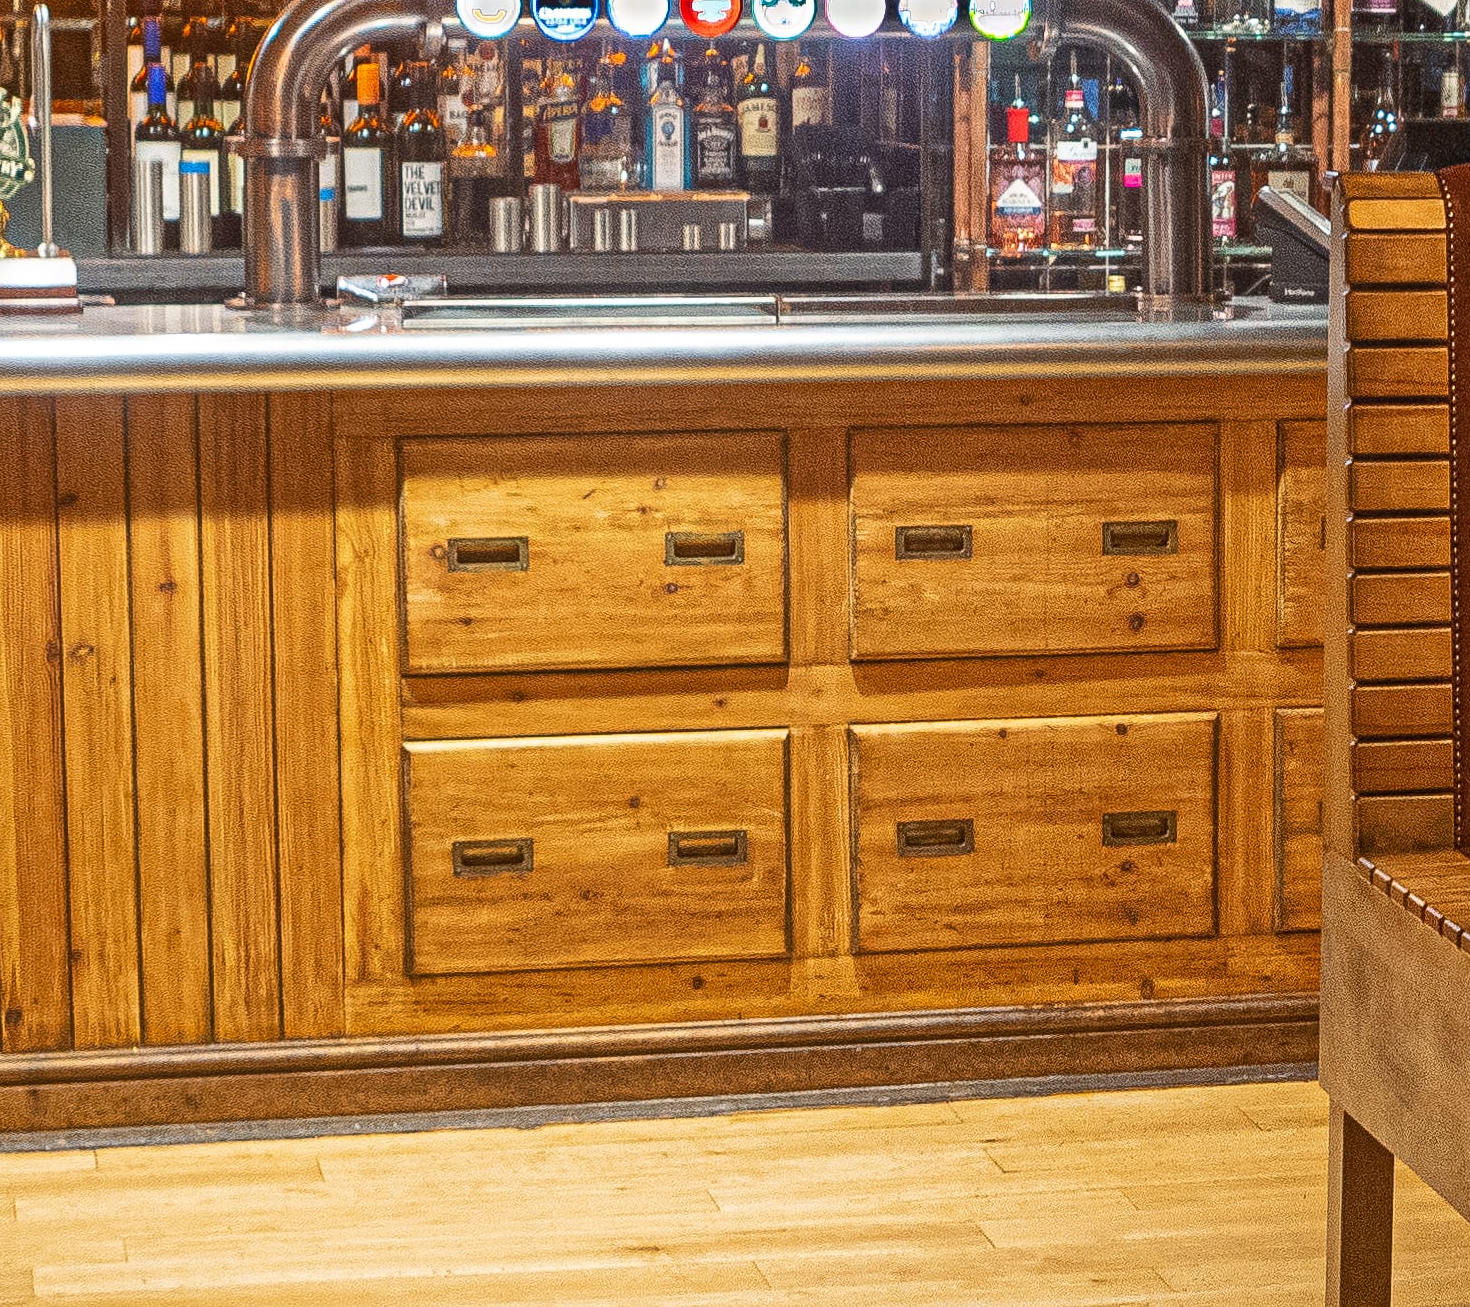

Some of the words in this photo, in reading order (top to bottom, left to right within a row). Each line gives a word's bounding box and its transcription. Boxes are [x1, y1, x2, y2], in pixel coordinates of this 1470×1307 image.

[405, 165, 424, 179] THE
[404, 181, 441, 194] VELVET
[405, 196, 435, 211] DEVIL
